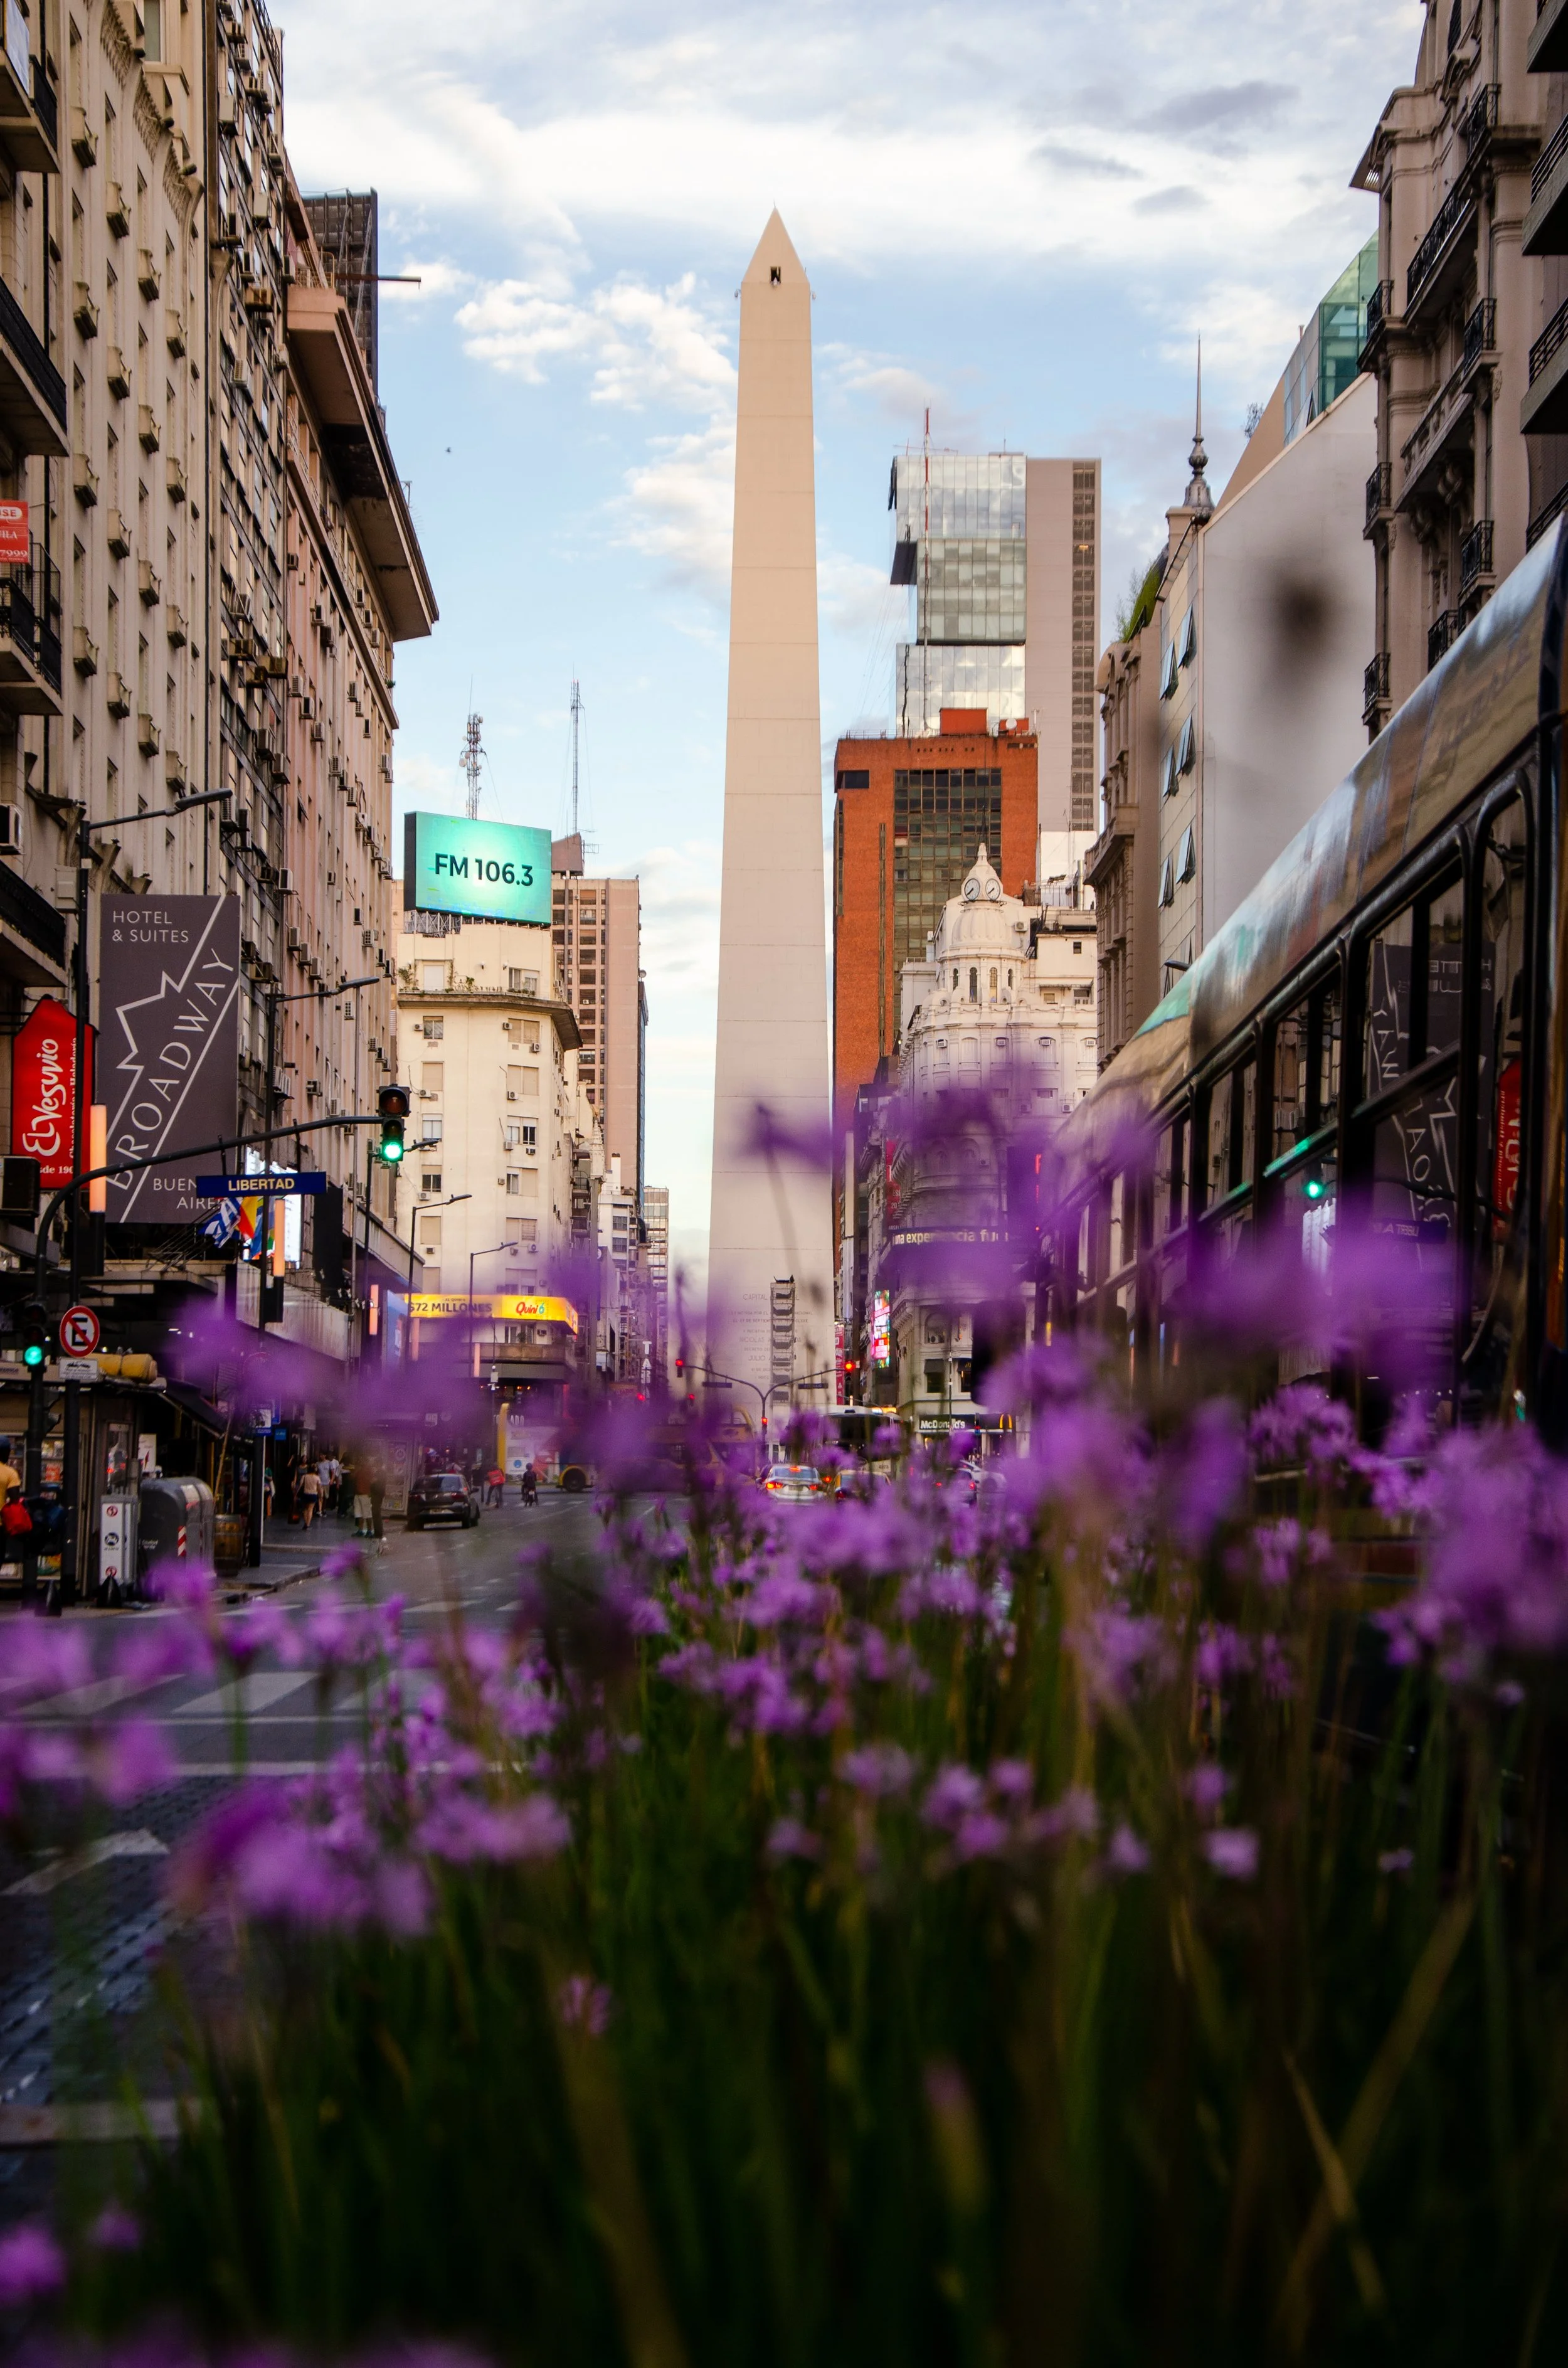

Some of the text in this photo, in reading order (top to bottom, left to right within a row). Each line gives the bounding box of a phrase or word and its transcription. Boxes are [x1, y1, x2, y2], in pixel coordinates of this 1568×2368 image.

[435, 853, 533, 886] FM 106.3
[113, 911, 172, 924] HOTEL
[112, 929, 189, 943] & SUITES
[105, 948, 234, 1190] BROADWAY
[31, 1038, 66, 1131] Vesuvio
[58, 1165, 73, 1174] 190
[153, 1178, 197, 1191] BUEN
[228, 1178, 295, 1191] LIBERTAD
[432, 1302, 492, 1313] MILLONES
[516, 1301, 545, 1315] Quini 6
[920, 1418, 966, 1430] McDonald's
